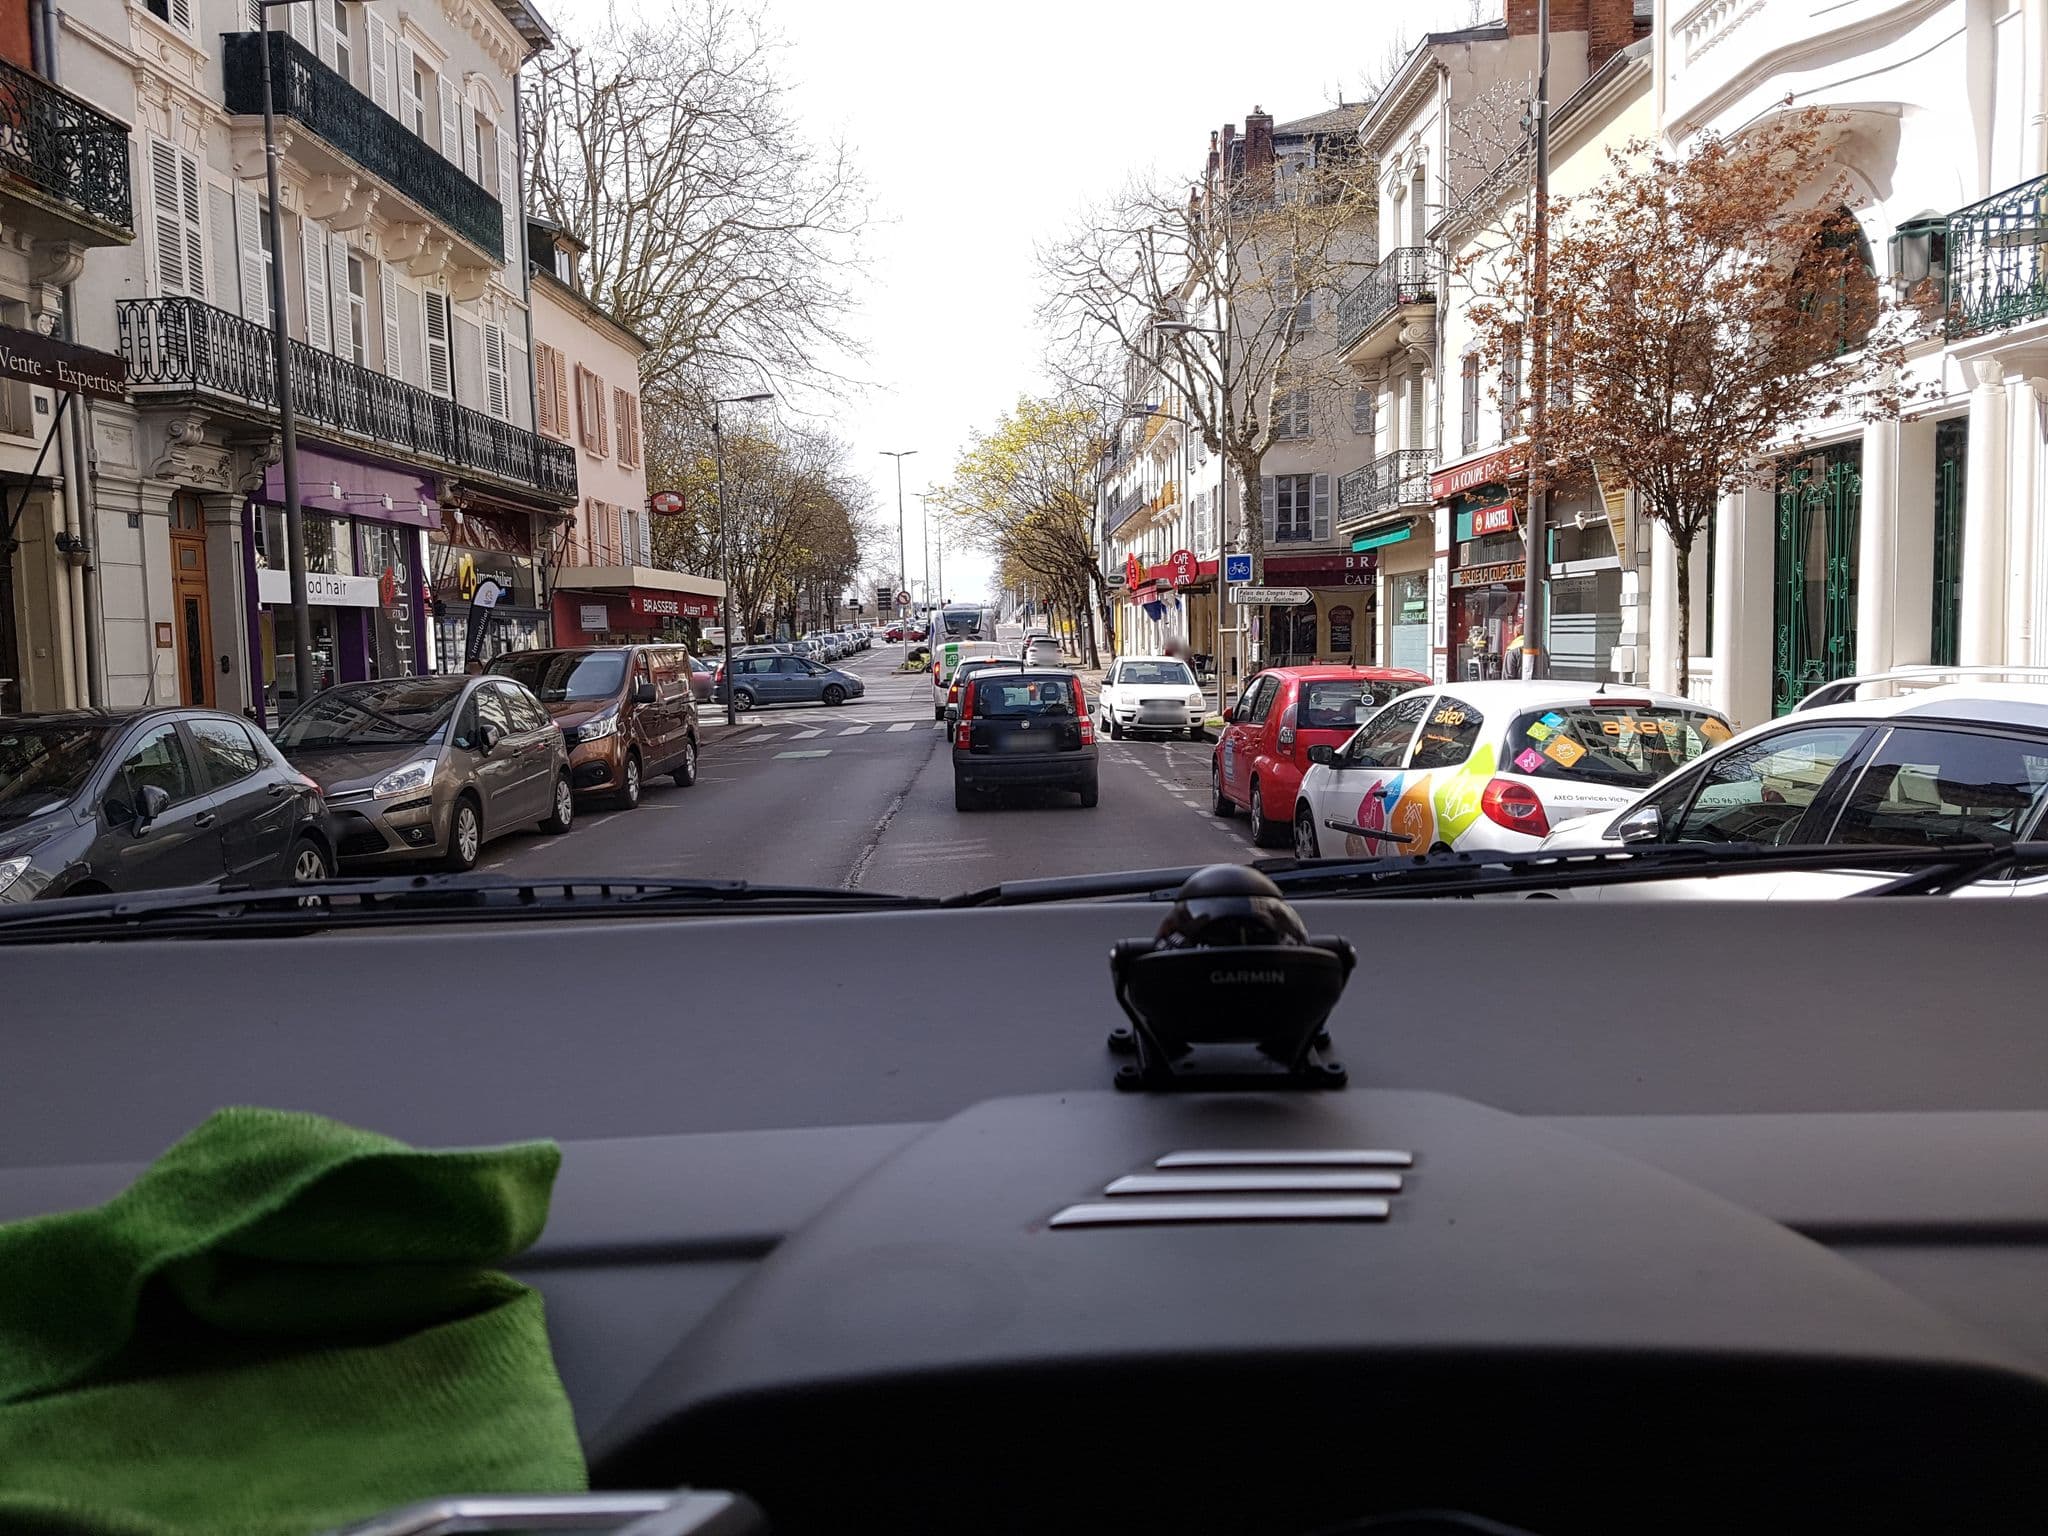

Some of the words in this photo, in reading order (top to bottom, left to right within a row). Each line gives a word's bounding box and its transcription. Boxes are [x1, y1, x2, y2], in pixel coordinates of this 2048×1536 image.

[0, 345, 42, 376] Vente
[57, 360, 125, 394] Expertise
[1450, 476, 1460, 492] LA
[1460, 464, 1486, 487] COUPE
[1485, 509, 1509, 530] AMSTEL
[1481, 567, 1489, 582] LA
[1490, 564, 1510, 581] COUPE
[643, 598, 679, 615] BRASSERIE
[1575, 794, 1608, 802] Services
[1608, 796, 1629, 805] Vichy
[1210, 970, 1286, 985] GARMIN
